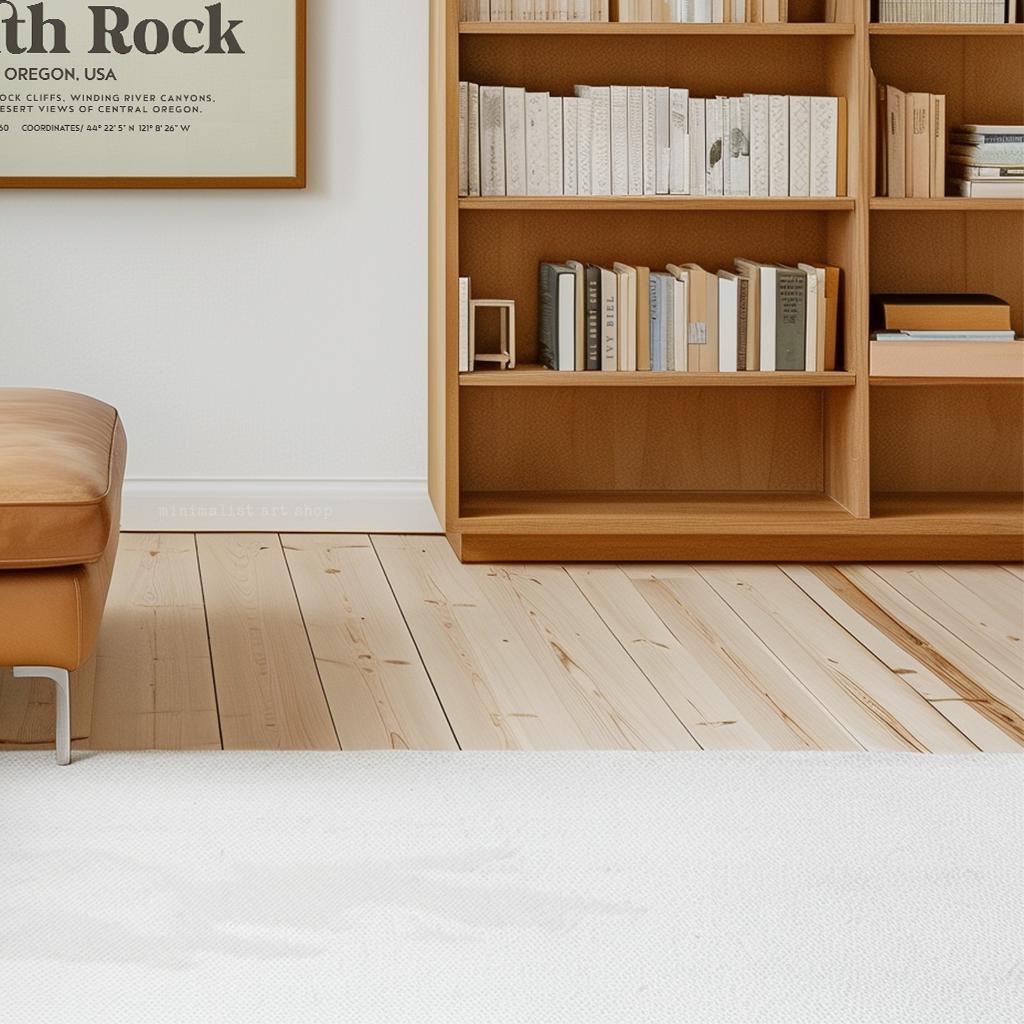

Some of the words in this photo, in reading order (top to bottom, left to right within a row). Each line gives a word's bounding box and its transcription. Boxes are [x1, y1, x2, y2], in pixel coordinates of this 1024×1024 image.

[87, 2, 246, 54] Rock
[4, 67, 80, 82] OREGON,
[84, 67, 118, 81] USA
[26, 93, 66, 103] CLIFFS,
[70, 93, 120, 102] WINDING
[124, 93, 156, 102] RIVER
[38, 104, 75, 113] VIEWS
[78, 104, 94, 113] OF
[97, 104, 149, 113] CENTRAL
[21, 123, 85, 133] COORDINATES/
[128, 123, 135, 132] N
[180, 123, 191, 132] W
[589, 281, 598, 304] CATS
[605, 296, 614, 327] BIEL
[589, 344, 598, 361] ALL
[605, 335, 614, 360] IVY
